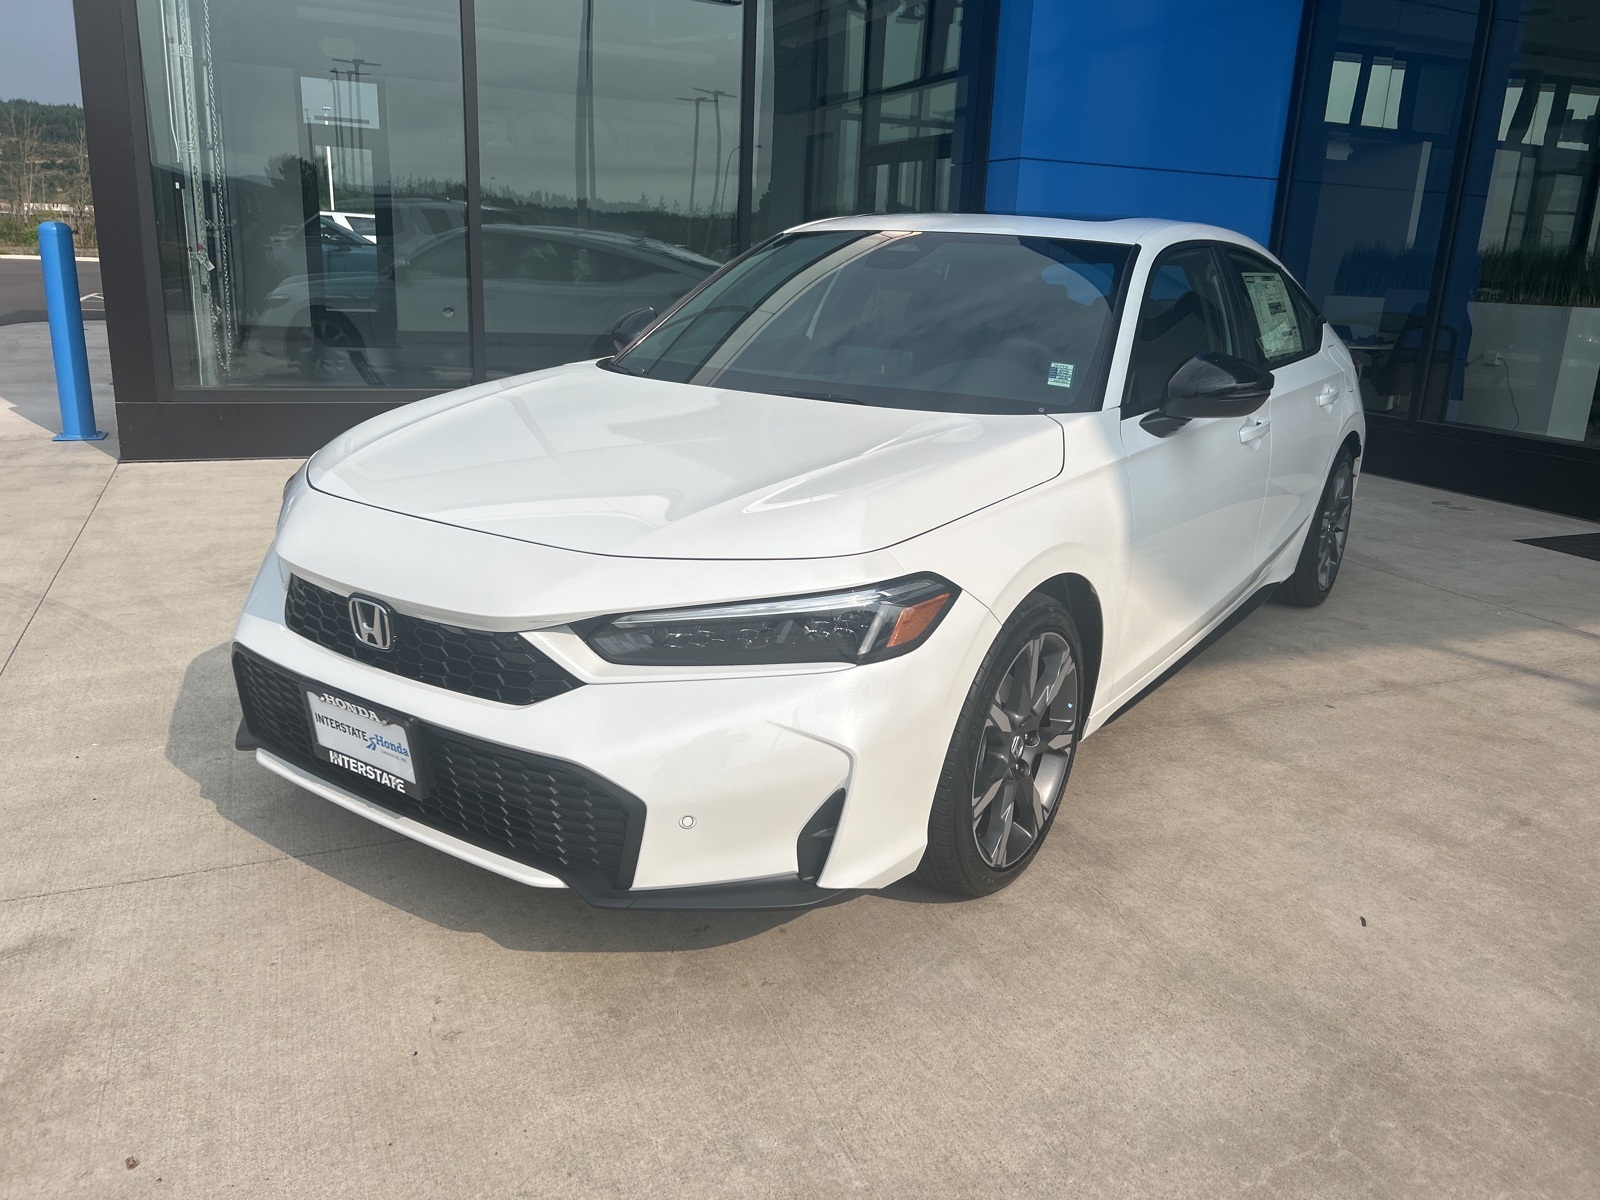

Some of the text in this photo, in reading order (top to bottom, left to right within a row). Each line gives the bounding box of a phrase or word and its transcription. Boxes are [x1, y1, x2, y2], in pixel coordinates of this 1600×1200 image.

[323, 693, 381, 723] HONDA
[315, 712, 368, 742] INTERSTATE
[374, 734, 409, 757] Honda
[329, 750, 405, 793] INTERSTATE
